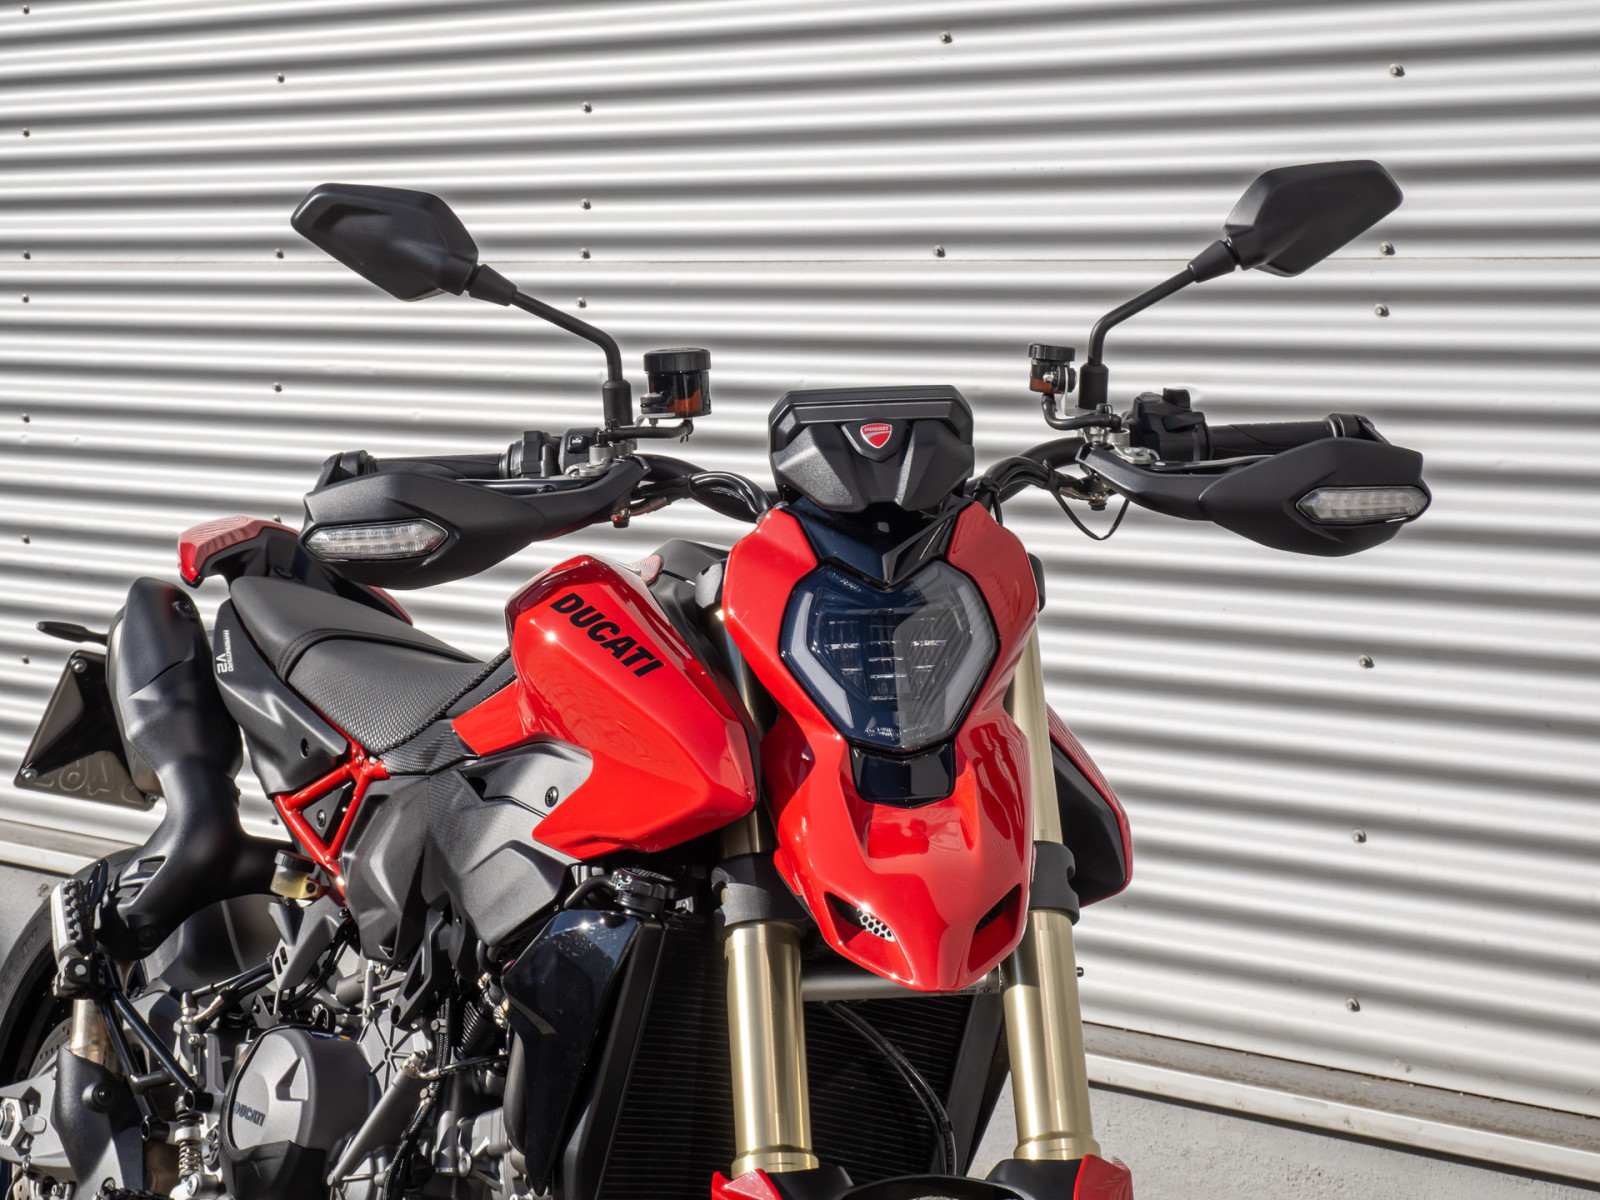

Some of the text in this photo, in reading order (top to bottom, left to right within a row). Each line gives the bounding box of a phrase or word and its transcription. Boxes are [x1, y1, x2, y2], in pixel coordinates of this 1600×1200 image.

[549, 592, 665, 678] DUCATI
[215, 652, 228, 674] V2
[234, 1100, 266, 1127] DUCATI
